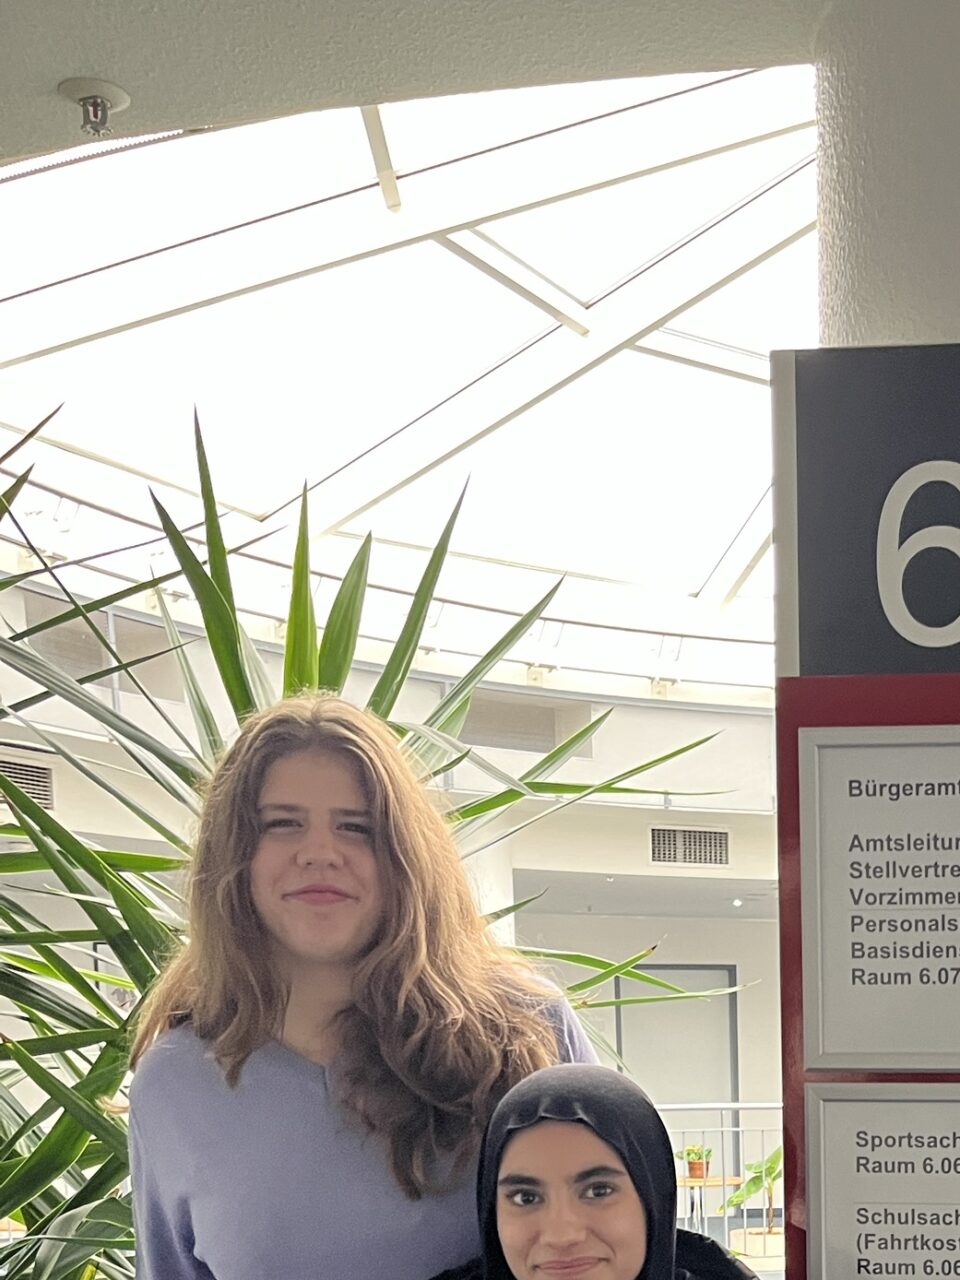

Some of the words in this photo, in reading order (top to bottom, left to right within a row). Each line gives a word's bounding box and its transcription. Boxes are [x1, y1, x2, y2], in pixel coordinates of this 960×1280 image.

[851, 967, 912, 986] Raum
[856, 1156, 915, 1175] Raum
[857, 1258, 916, 1276] Raum
